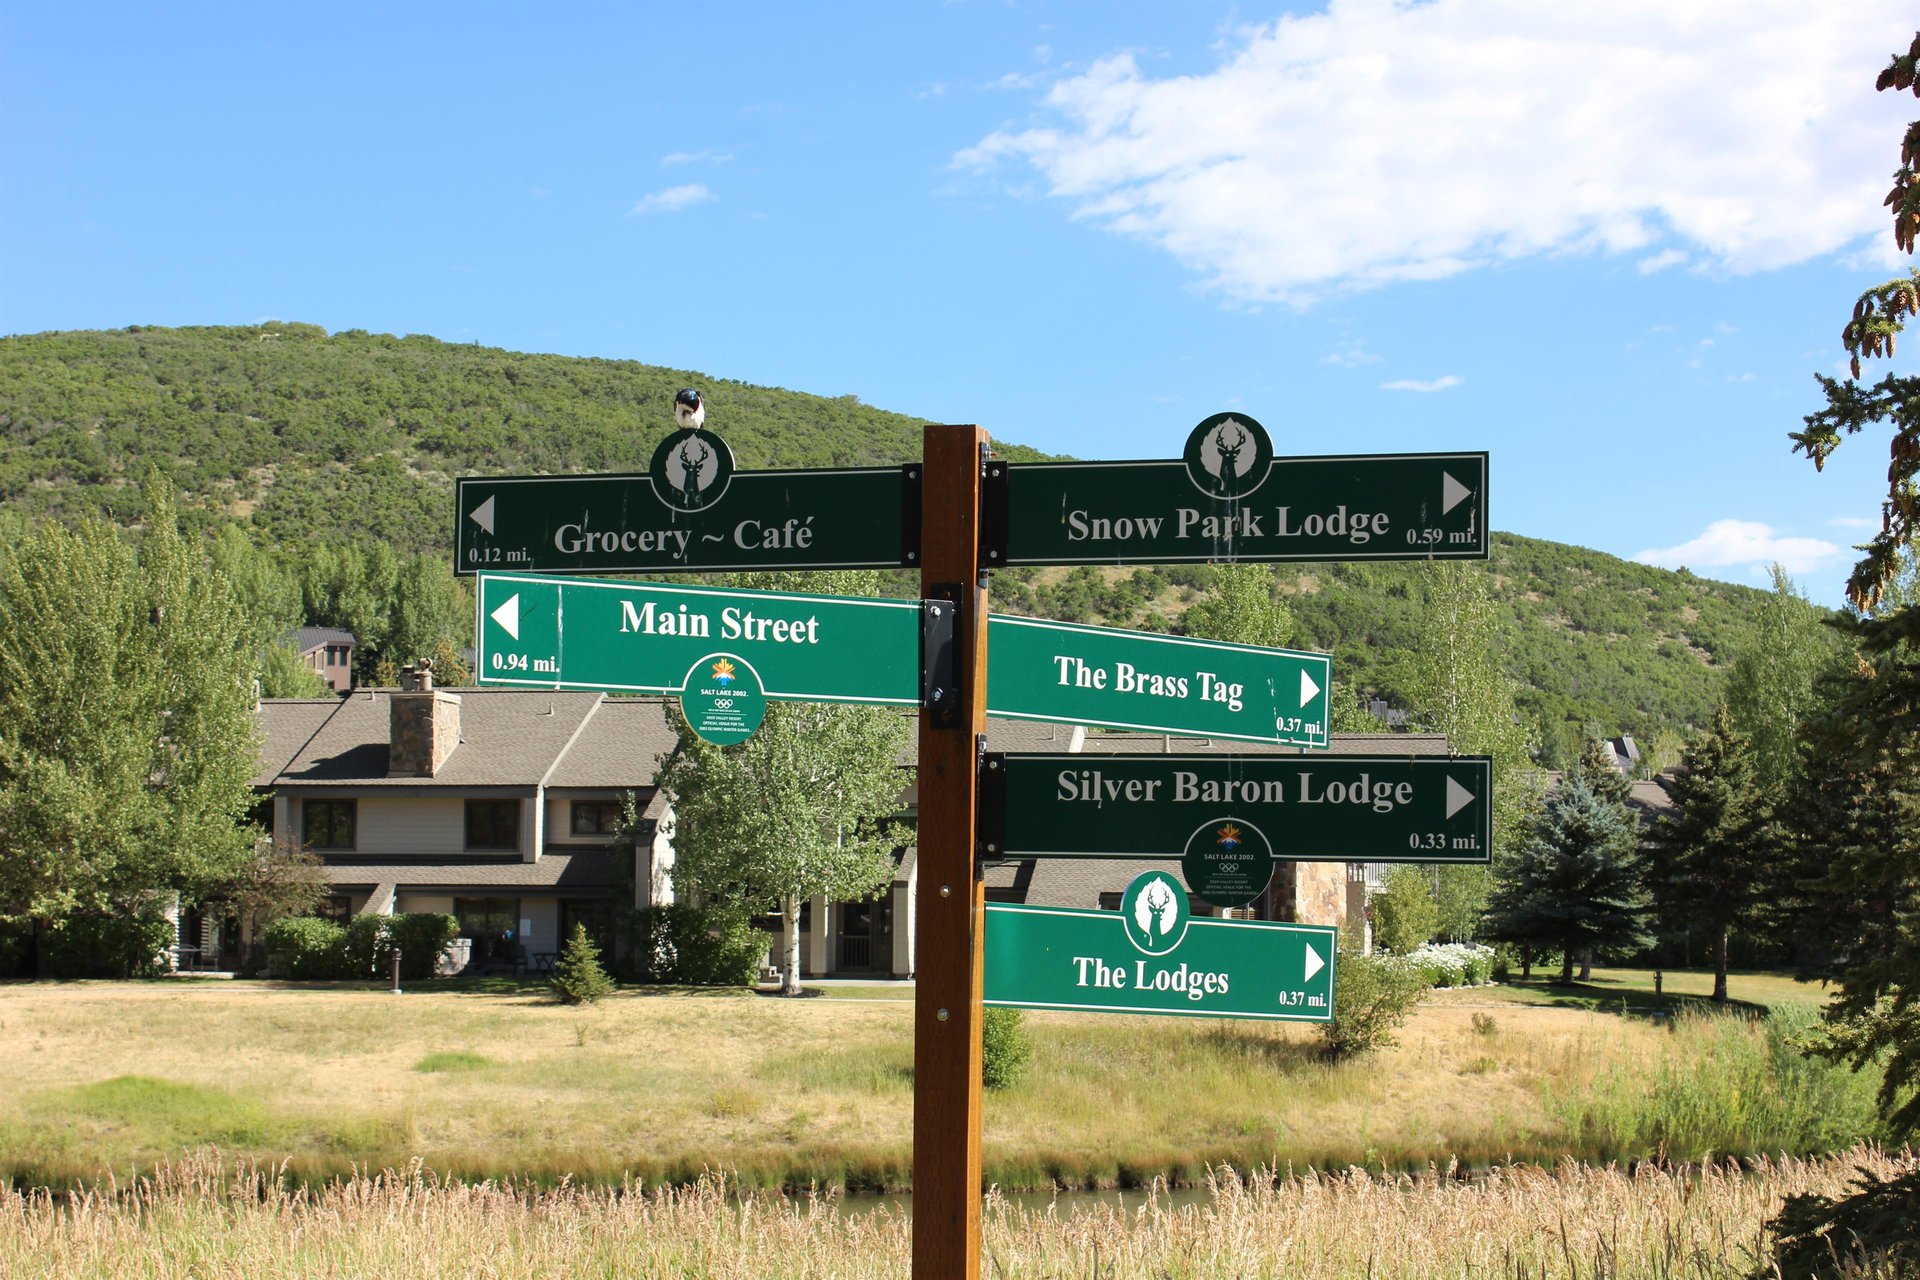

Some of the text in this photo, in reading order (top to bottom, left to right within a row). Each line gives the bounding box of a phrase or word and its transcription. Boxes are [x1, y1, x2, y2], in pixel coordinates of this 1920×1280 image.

[553, 523, 691, 559] Grocery
[733, 516, 815, 550] Café
[1067, 505, 1389, 544] Snow Park Lodge
[1406, 527, 1477, 545] 0.59 mi.
[468, 546, 532, 563] 0.12 mi.
[619, 600, 819, 645] Main Street
[492, 652, 561, 673] 0.94 mi.
[1054, 655, 1244, 712] The Brass Tag
[1276, 716, 1324, 735] 0.37 mi.
[1056, 769, 1413, 813] Silver Baron Lodge
[1409, 833, 1480, 850] 0.33 mi.
[1072, 956, 1229, 1001] The Lodges
[1279, 990, 1327, 1007] 0.37 mi.
